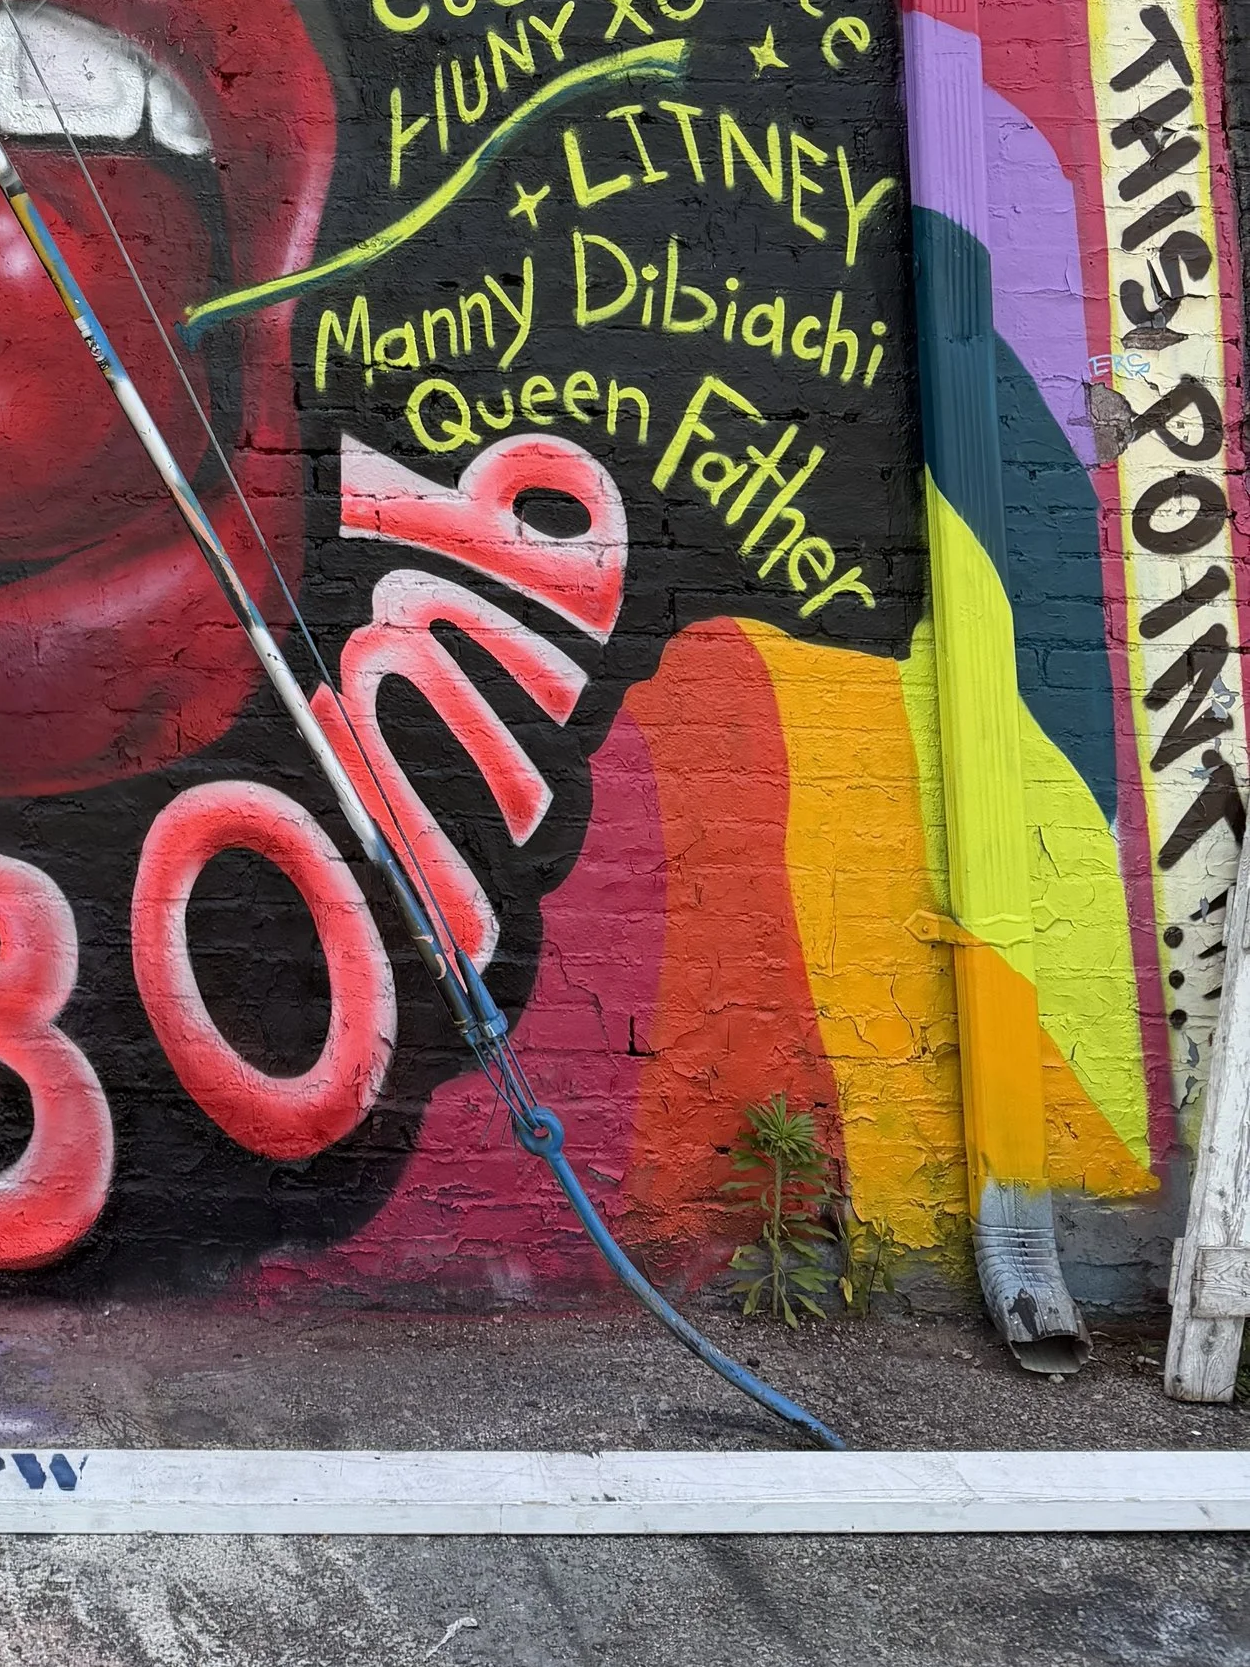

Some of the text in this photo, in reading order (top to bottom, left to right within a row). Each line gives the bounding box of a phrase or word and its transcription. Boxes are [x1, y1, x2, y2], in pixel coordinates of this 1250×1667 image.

[389, 0, 576, 189] HUNY
[1108, 3, 1214, 326] THIS
[561, 100, 897, 267] LITNEY
[314, 255, 535, 392] Manny
[573, 230, 888, 389] Dibiachi
[405, 369, 651, 454] Queen
[651, 374, 876, 619] Father
